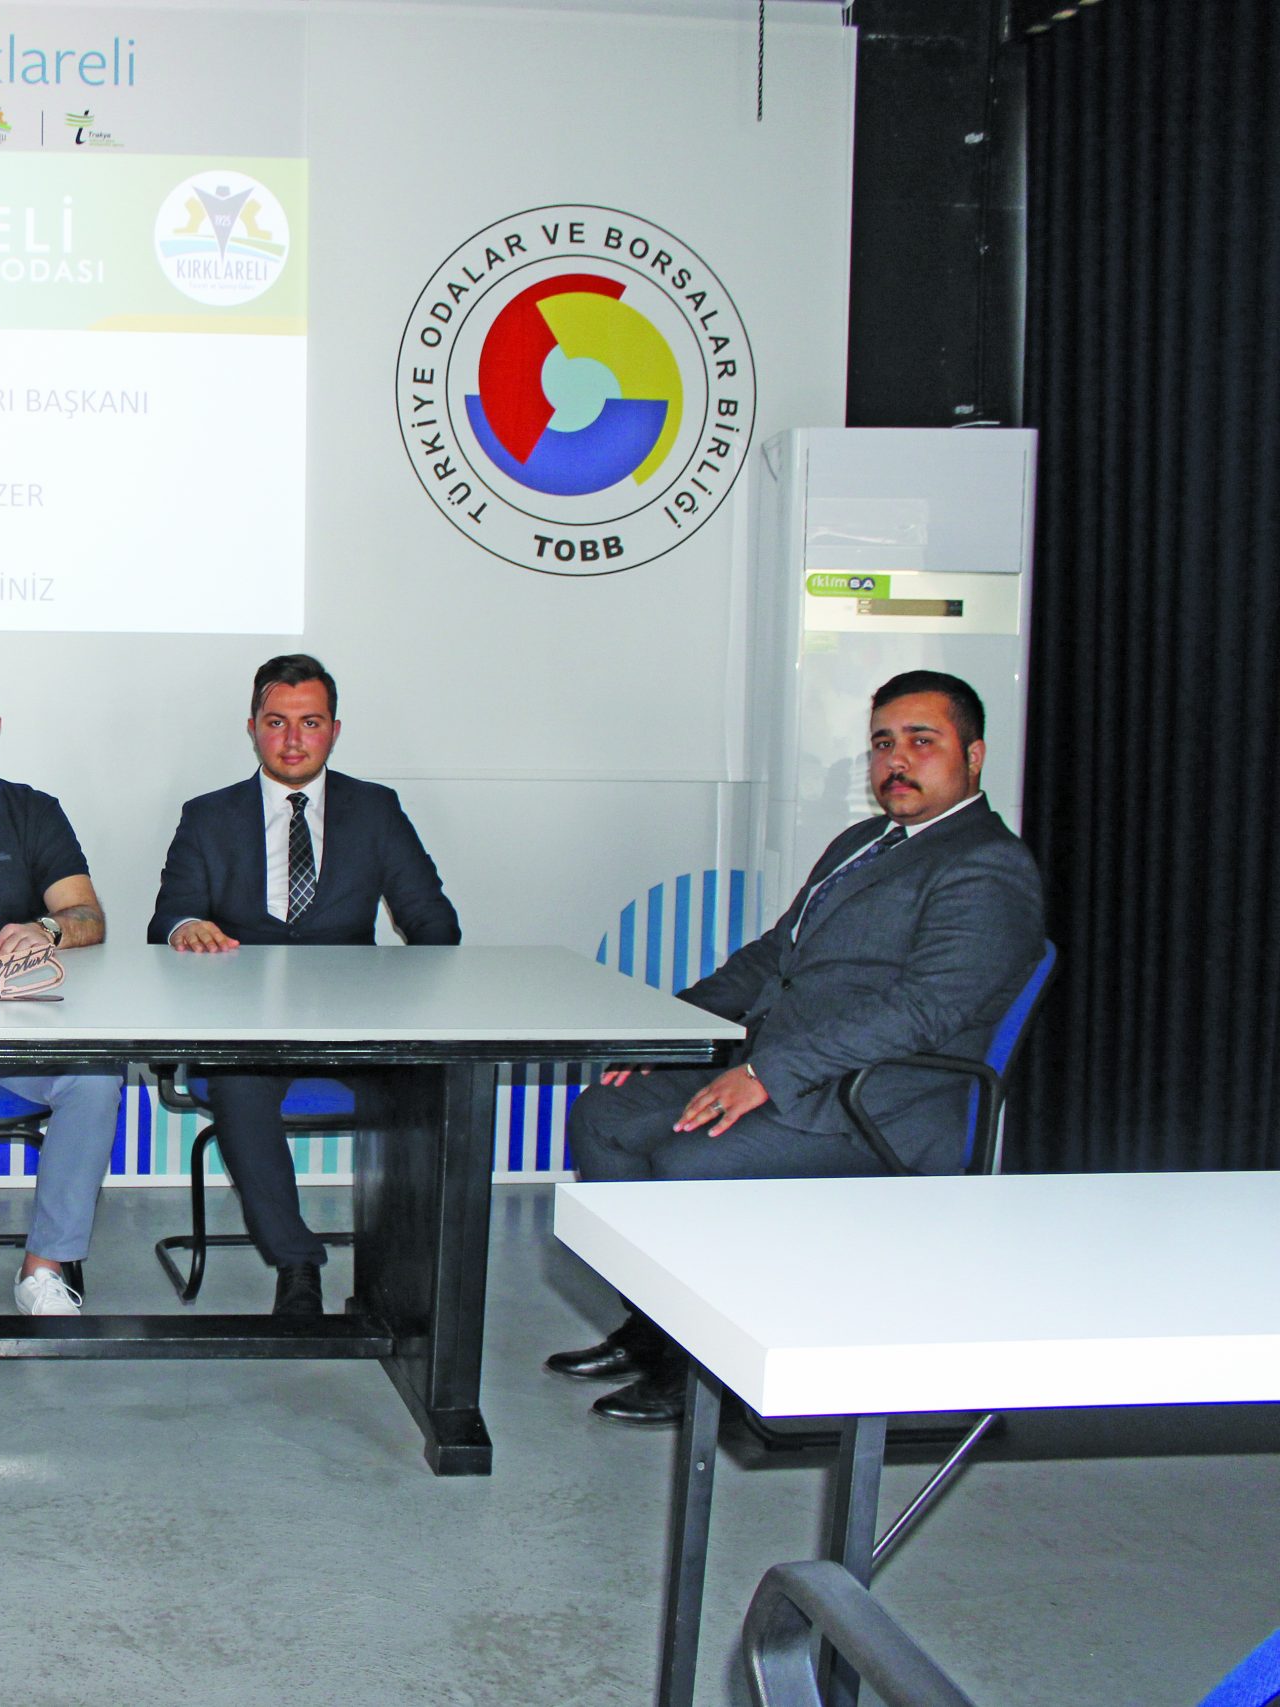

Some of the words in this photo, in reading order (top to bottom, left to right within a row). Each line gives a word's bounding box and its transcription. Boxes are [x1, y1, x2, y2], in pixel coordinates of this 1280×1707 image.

[0, 256, 105, 284] ODASI
[541, 221, 586, 246] VE
[420, 233, 528, 349] ODALAR
[604, 226, 738, 381] BORSALAR
[25, 388, 149, 419] BAŞKANI
[411, 366, 486, 525] TÜRKİYE
[663, 398, 739, 528] BİRLİĞİ
[533, 534, 625, 562] TOBB
